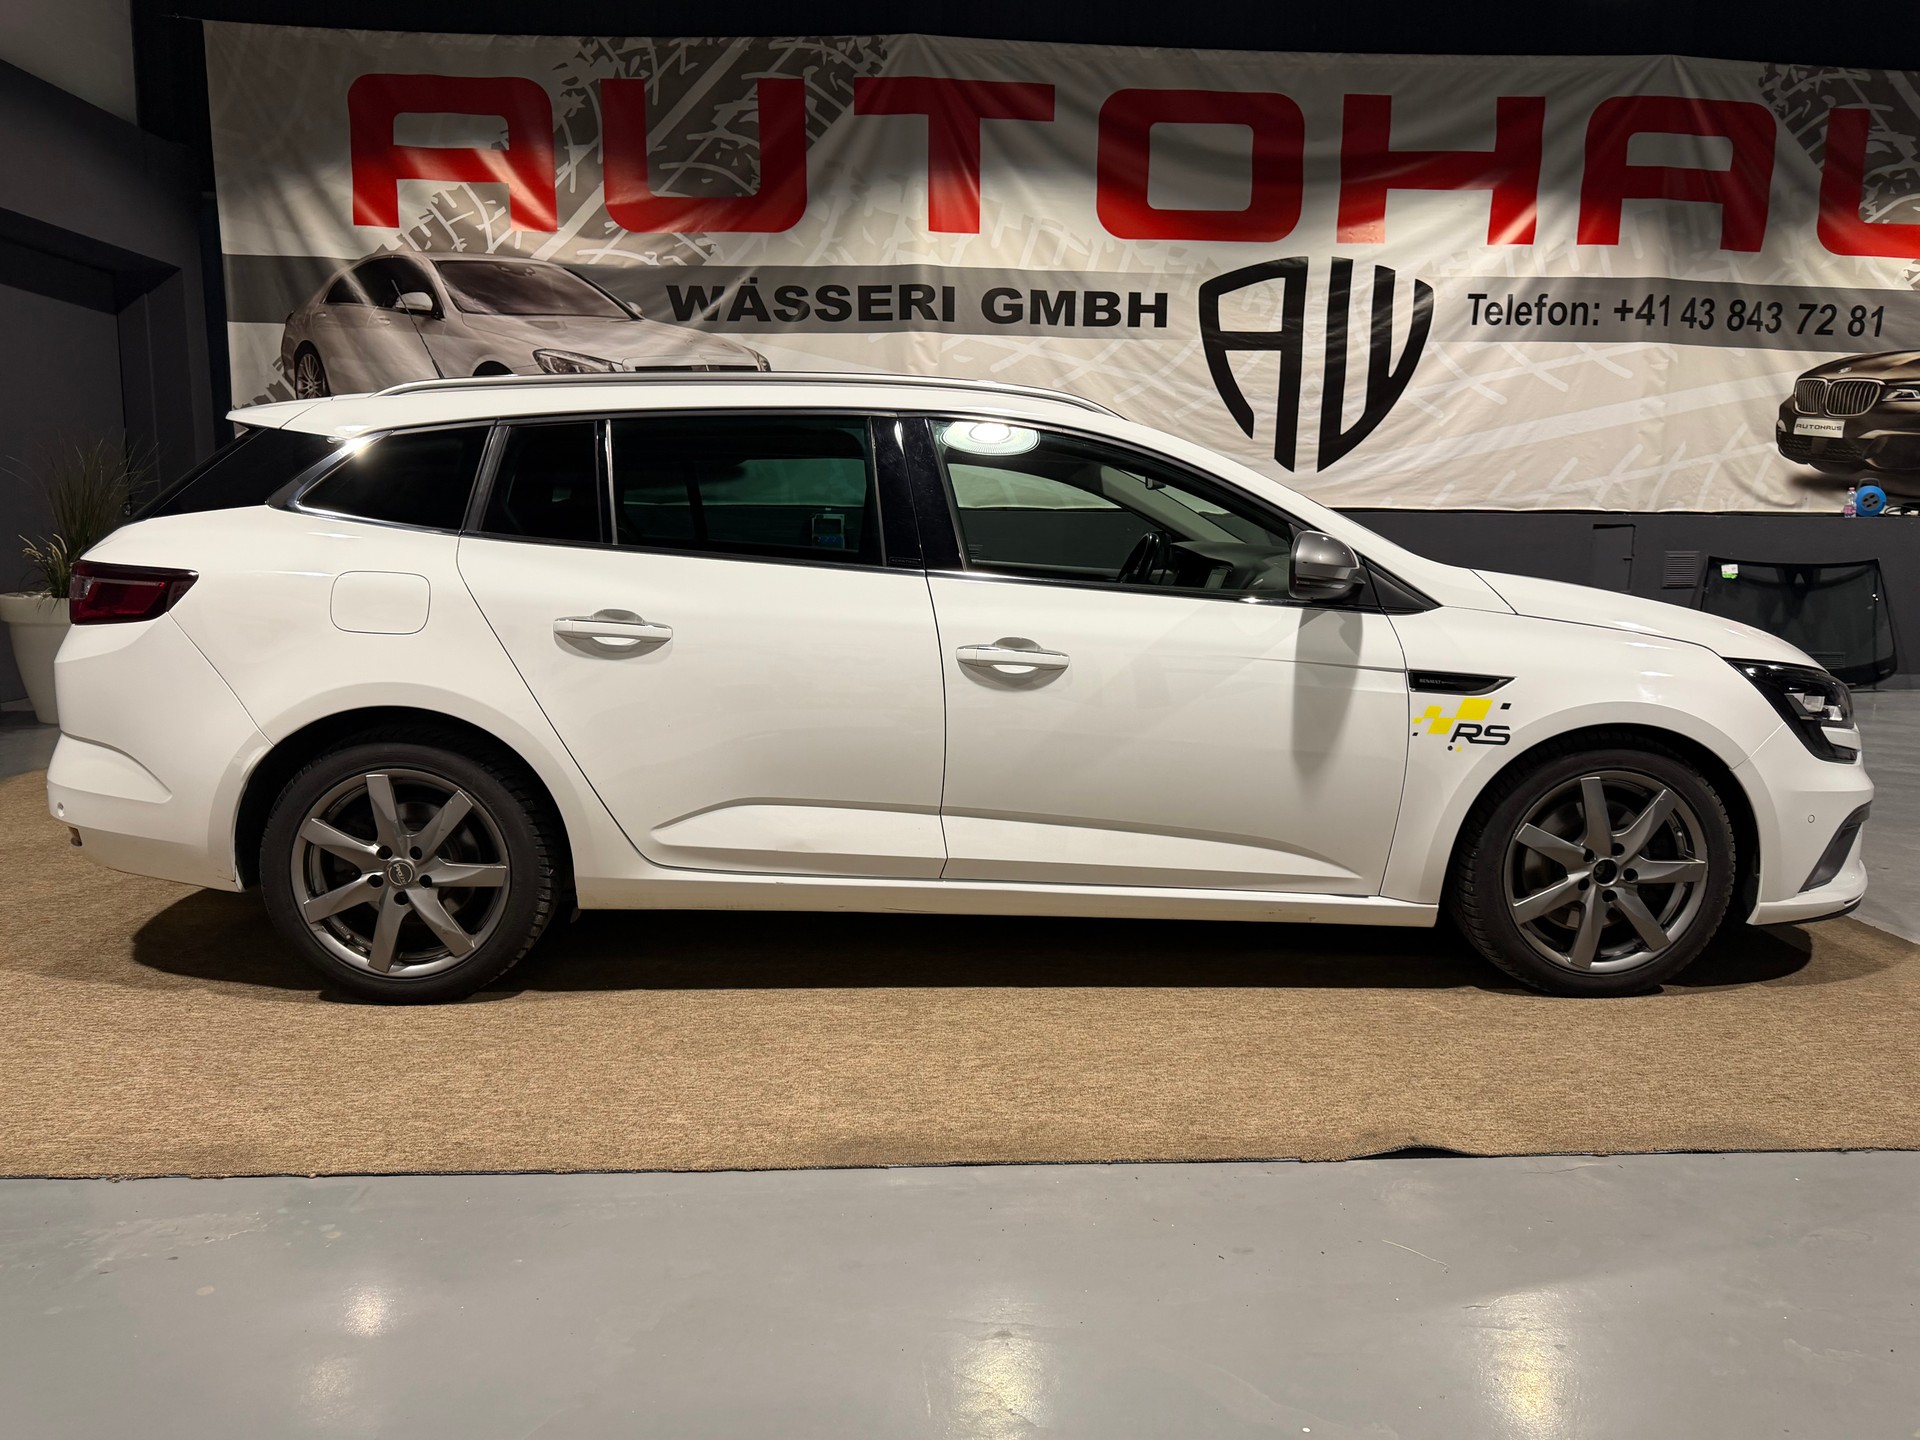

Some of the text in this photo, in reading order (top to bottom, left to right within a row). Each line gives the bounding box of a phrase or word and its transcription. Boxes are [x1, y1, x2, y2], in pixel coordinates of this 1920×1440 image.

[665, 277, 1169, 328] WÄSSERI GMBH
[1467, 293, 1885, 338] Telefon: +41 43 843 72 81
[1795, 423, 1842, 431] AUTOHAUS
[1449, 723, 1511, 746] RS
